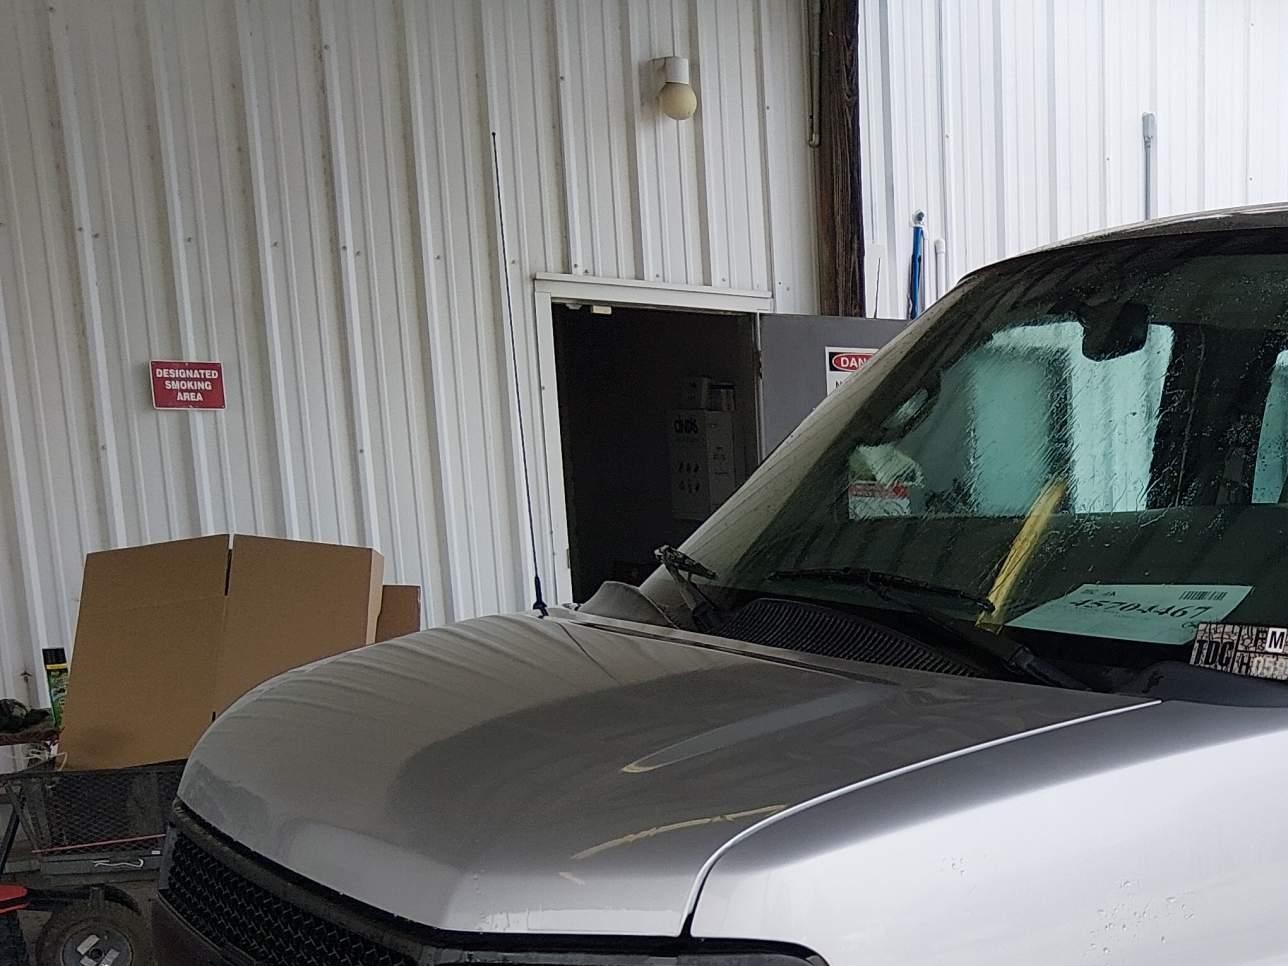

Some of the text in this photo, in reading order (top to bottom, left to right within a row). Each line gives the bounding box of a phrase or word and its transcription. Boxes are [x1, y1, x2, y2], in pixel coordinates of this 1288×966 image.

[840, 357, 867, 368] DAN
[156, 369, 218, 379] DESIGNATED
[165, 381, 212, 390] SMOKING
[177, 392, 203, 401] AREA
[1070, 599, 1212, 619] 45704467
[1268, 631, 1285, 650] M
